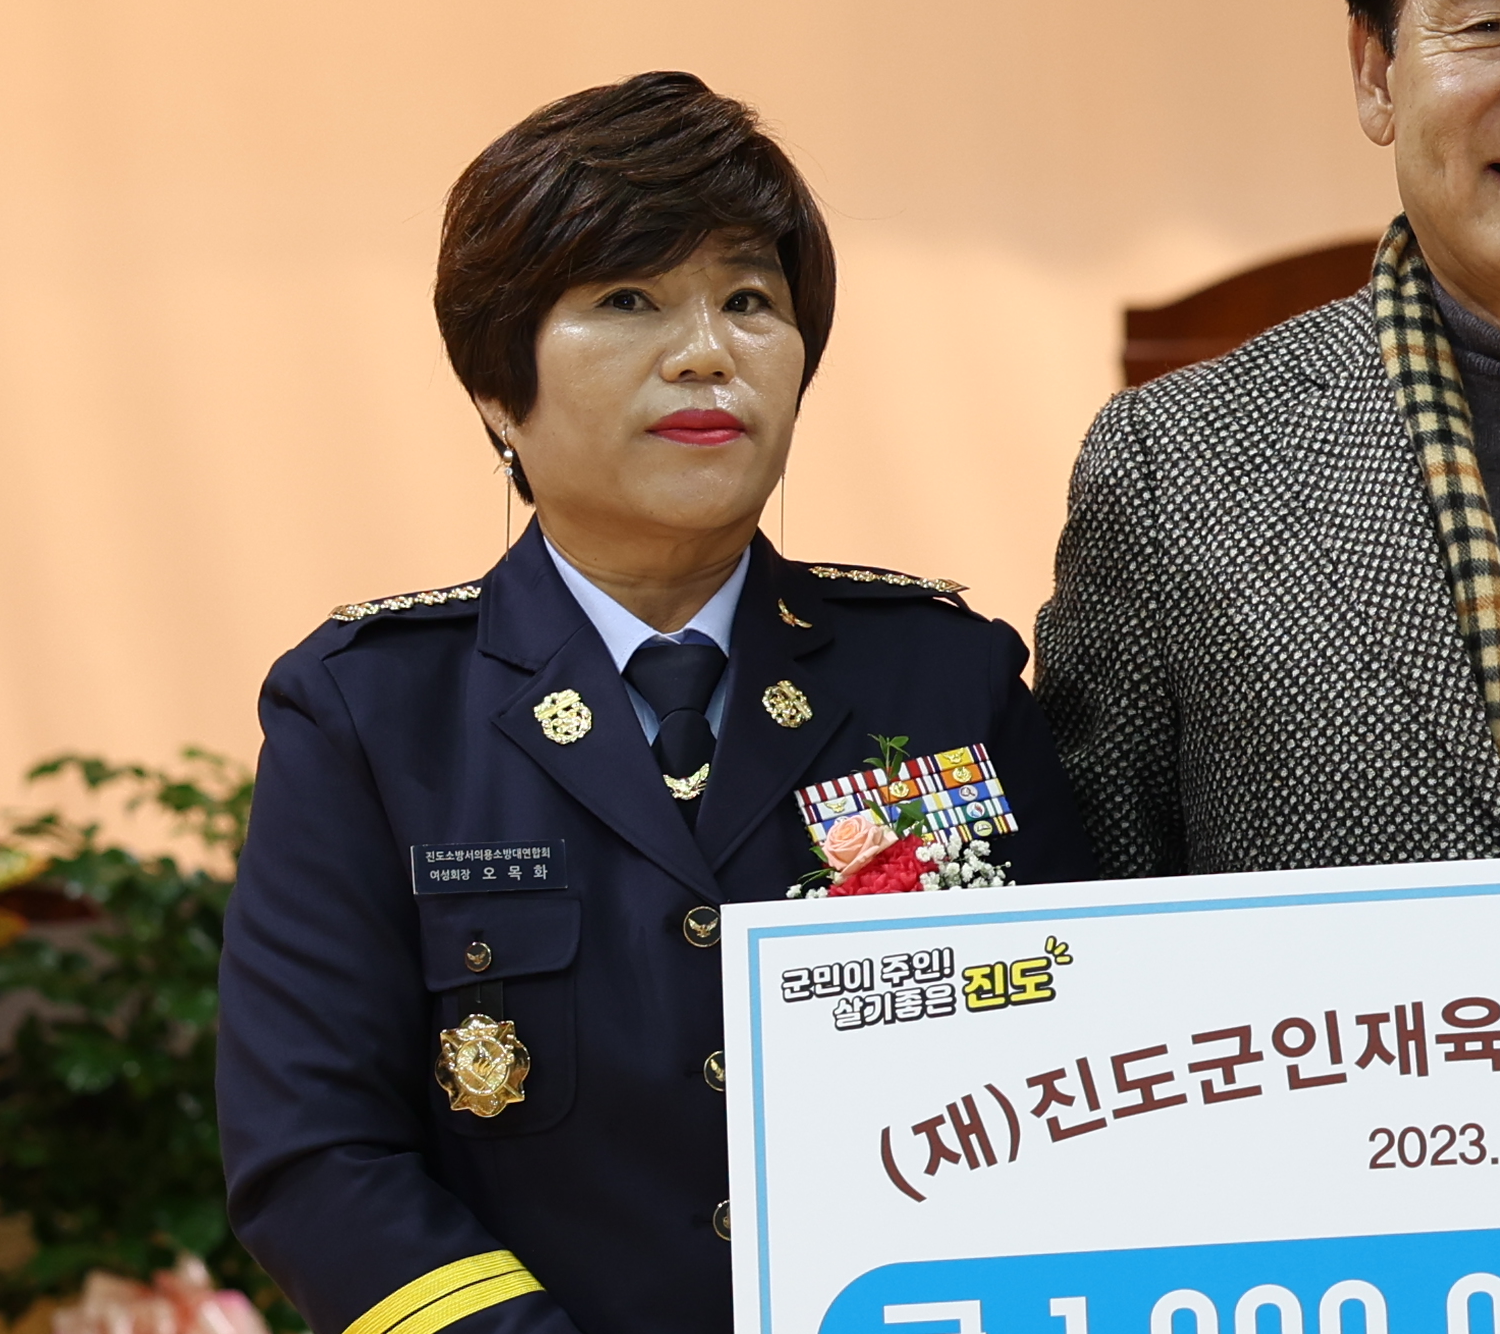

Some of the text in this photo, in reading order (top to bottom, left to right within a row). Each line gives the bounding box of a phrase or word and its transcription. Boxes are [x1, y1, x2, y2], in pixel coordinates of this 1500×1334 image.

[425, 846, 551, 863] 진도소방서의용소방대연합회
[429, 868, 471, 882] 여성회장
[781, 946, 955, 1003] 군민이 주인!
[831, 955, 1057, 1032] 살기좋은 진도
[1367, 1121, 1500, 1171] 2023.
